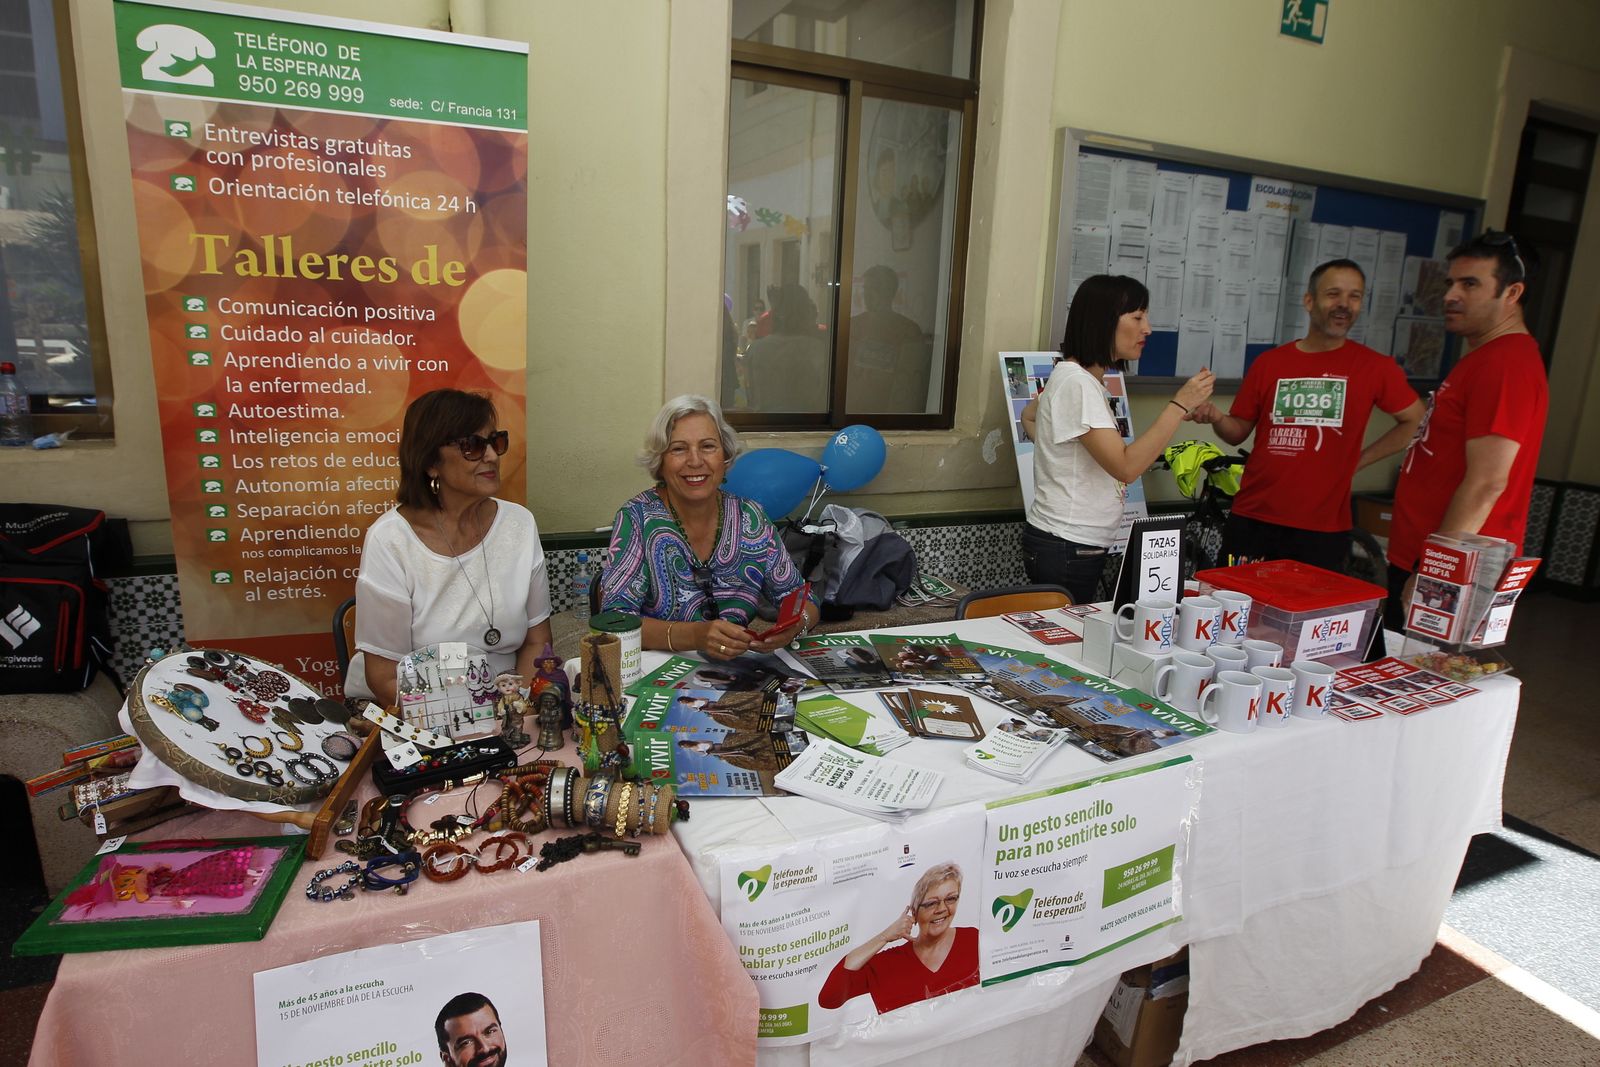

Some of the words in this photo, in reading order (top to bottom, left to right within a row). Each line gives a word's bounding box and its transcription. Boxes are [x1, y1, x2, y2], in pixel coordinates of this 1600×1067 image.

[234, 31, 329, 58] TELÉFONO
[338, 45, 360, 62] DE
[236, 53, 258, 70] LA
[262, 57, 362, 82] ESPERANZA
[238, 74, 278, 96] 950
[284, 78, 322, 99] 269
[328, 83, 364, 104] 999
[389, 97, 423, 111] sede:
[431, 100, 446, 114] C/
[448, 102, 493, 118] Francia
[496, 108, 517, 120] 131
[204, 122, 319, 152] Entrevistas
[325, 136, 412, 160] gratuitas
[206, 150, 244, 166] con
[251, 151, 387, 179] profesionales
[208, 177, 330, 203] Orientación
[336, 188, 431, 211] telefónica
[436, 194, 460, 212] 24
[465, 198, 477, 214] h
[188, 232, 399, 283] Talleres
[411, 244, 467, 287] de
[218, 297, 358, 320] Comunicación
[364, 304, 436, 322] positiva
[220, 323, 303, 344] Cuidado
[308, 327, 326, 344] al
[330, 329, 417, 347] cuidador.
[223, 351, 351, 374] Aprendiendo
[356, 358, 368, 371] a
[372, 356, 412, 372] vivir
[417, 358, 449, 373] con
[225, 376, 243, 393] la
[249, 377, 372, 395] enfermedad.
[228, 402, 345, 419] Autoestima.
[1282, 393, 1332, 409] 1036
[230, 428, 340, 447] Inteligencia
[1268, 437, 1305, 447] SOLIDARIA
[1269, 427, 1307, 438] CARRERA
[232, 454, 266, 470] Los
[270, 454, 319, 469] retos
[323, 452, 346, 469] de
[235, 477, 341, 495] Autonomía
[237, 502, 340, 520] Separación
[240, 523, 361, 544] Aprendiendo
[1149, 536, 1176, 548] TAZAS
[242, 548, 264, 559] nos
[268, 545, 348, 559] complicamos
[351, 544, 361, 555] la
[1143, 549, 1178, 560] SOLIDARIAS
[244, 565, 337, 585] Relajación
[1424, 558, 1455, 571] asociado
[1148, 566, 1171, 592] 5€
[245, 587, 261, 601] al
[266, 585, 327, 600] estrés.
[826, 767, 845, 787] CAMBIE
[999, 824, 1019, 842] Un
[1023, 815, 1062, 841] gesto
[1064, 799, 1113, 827] sencillo
[995, 844, 1032, 865] para
[1036, 839, 1054, 856] no
[1057, 822, 1108, 850] sentirte
[1110, 814, 1137, 834] solo
[773, 868, 804, 881] Teléfono
[805, 865, 813, 874] de
[994, 870, 1003, 880] Tu
[1005, 867, 1019, 879] voz
[1021, 867, 1030, 877] se
[1031, 861, 1061, 876] escucha
[1063, 853, 1088, 871] siempre
[1123, 867, 1135, 879] 950
[1135, 865, 1142, 874] 26
[1142, 861, 1151, 871] 99
[1150, 857, 1159, 867] 99
[773, 882, 780, 890] la
[780, 874, 818, 889] esperanza
[1033, 908, 1042, 919] la
[1044, 901, 1086, 919] esperanza
[1034, 896, 1073, 909] Teléfono
[1074, 890, 1084, 901] de
[755, 923, 785, 935] NOVIEMBRE
[786, 920, 794, 929] DÍA
[809, 910, 831, 922] ESCUCHA
[768, 916, 781, 925] años
[785, 912, 790, 920] la
[791, 907, 811, 917] escucha
[1100, 922, 1114, 932] HAZTE
[1114, 916, 1128, 926] SOCIO
[1128, 912, 1137, 921] POR
[1137, 907, 1149, 917] SOLO
[739, 945, 755, 956] Un
[757, 942, 788, 959] gesto
[790, 931, 827, 949] sencillo
[828, 923, 849, 940] para
[778, 959, 784, 970] y
[786, 951, 801, 965] ser
[804, 935, 851, 960] escuchado
[768, 969, 794, 980] escucha
[794, 963, 818, 976] siempre
[278, 999, 295, 1009] Más
[296, 995, 307, 1004] de
[308, 992, 318, 1001] 45
[319, 988, 338, 999] años
[346, 984, 353, 992] la
[354, 979, 385, 992] escucha
[280, 1012, 289, 1021] 15
[290, 1009, 301, 1018] DE
[302, 997, 345, 1016] NOVIEMBRE
[346, 994, 360, 1005] DÍA
[361, 991, 371, 1001] DE
[371, 989, 381, 999] LA
[382, 984, 414, 997] ESCUCHA
[347, 1041, 397, 1064] sencillo
[396, 1051, 422, 1066] solo
